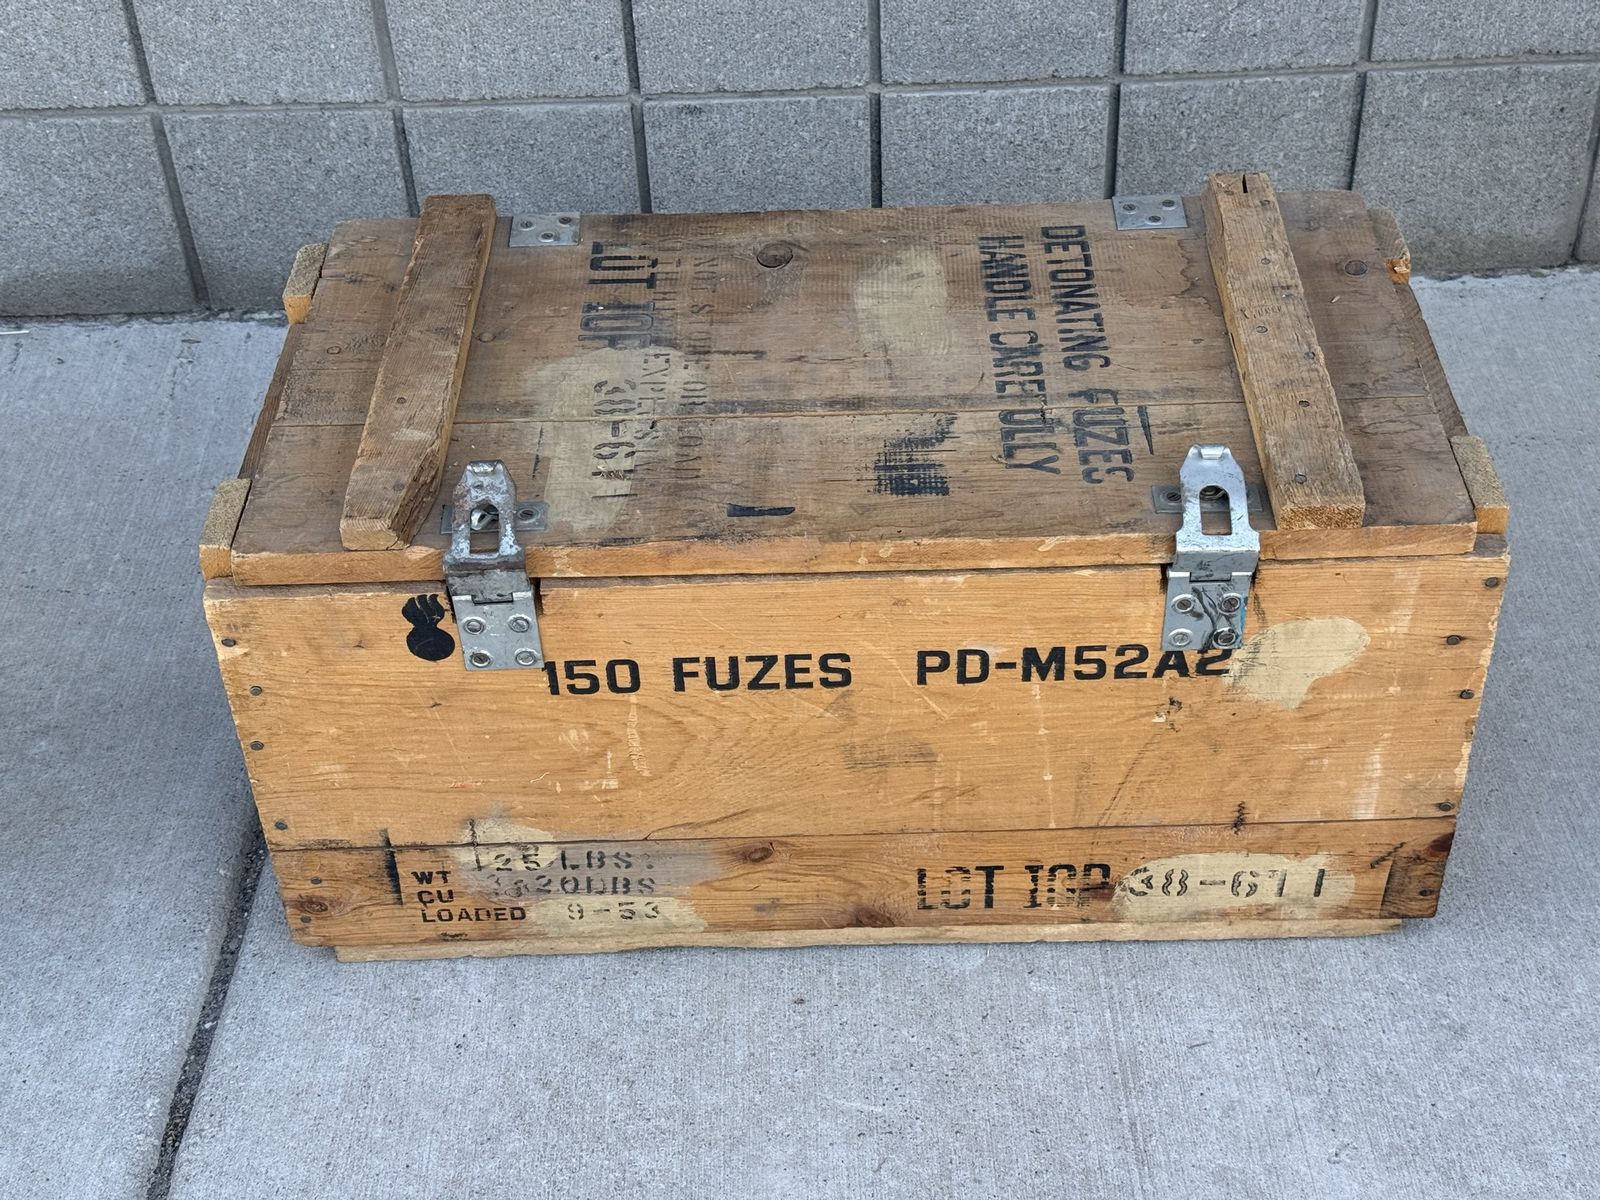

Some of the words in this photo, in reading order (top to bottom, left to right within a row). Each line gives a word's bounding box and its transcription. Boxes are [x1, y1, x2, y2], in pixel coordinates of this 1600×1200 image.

[585, 240, 659, 290] LOT
[977, 234, 1037, 322] HANDLE
[1040, 224, 1111, 371] DETONATING
[989, 329, 1062, 475] CAREFULLY
[1067, 387, 1136, 484] FUZES
[541, 658, 641, 696] 150
[672, 652, 852, 693] FUZES
[916, 643, 1234, 686] PD-M52A2
[410, 870, 451, 885] WT
[917, 865, 1004, 910] LOT
[421, 906, 527, 923] LOADED
[566, 902, 661, 921] 9-53
